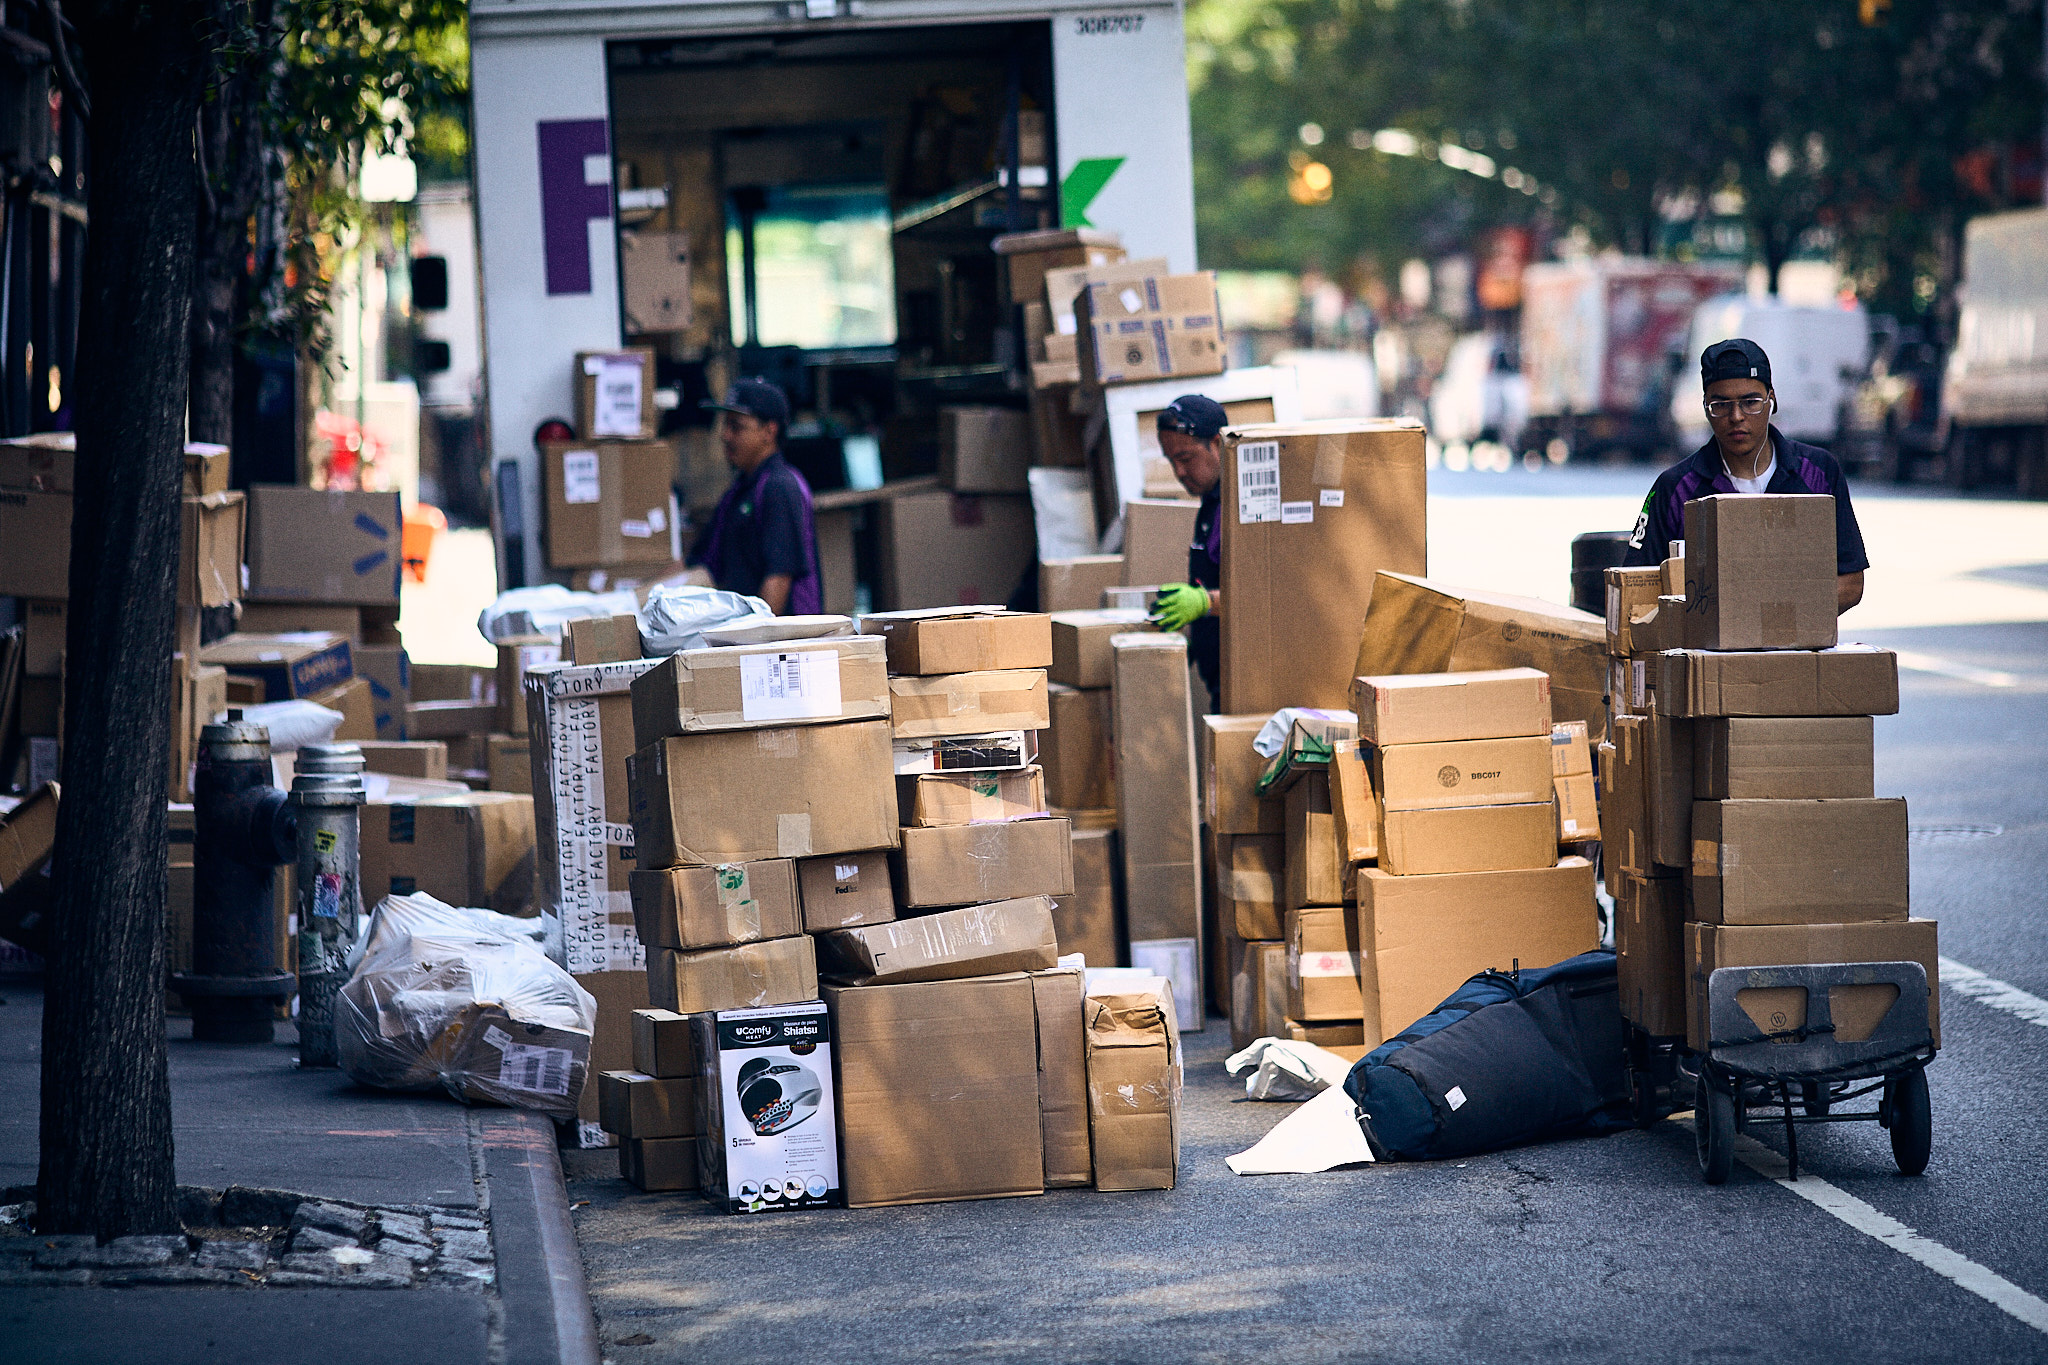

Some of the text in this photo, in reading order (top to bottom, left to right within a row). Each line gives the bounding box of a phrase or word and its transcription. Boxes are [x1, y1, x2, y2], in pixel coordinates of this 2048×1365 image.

[580, 700, 599, 774] FACTORY
[572, 762, 587, 837] FACTORY
[1471, 771, 1501, 780] BBC017
[561, 828, 576, 904] FACTORY
[588, 805, 604, 880] FACTORY
[577, 868, 591, 943] FACTORY
[783, 1026, 818, 1037] Shiatsu
[732, 1137, 738, 1148] 5
